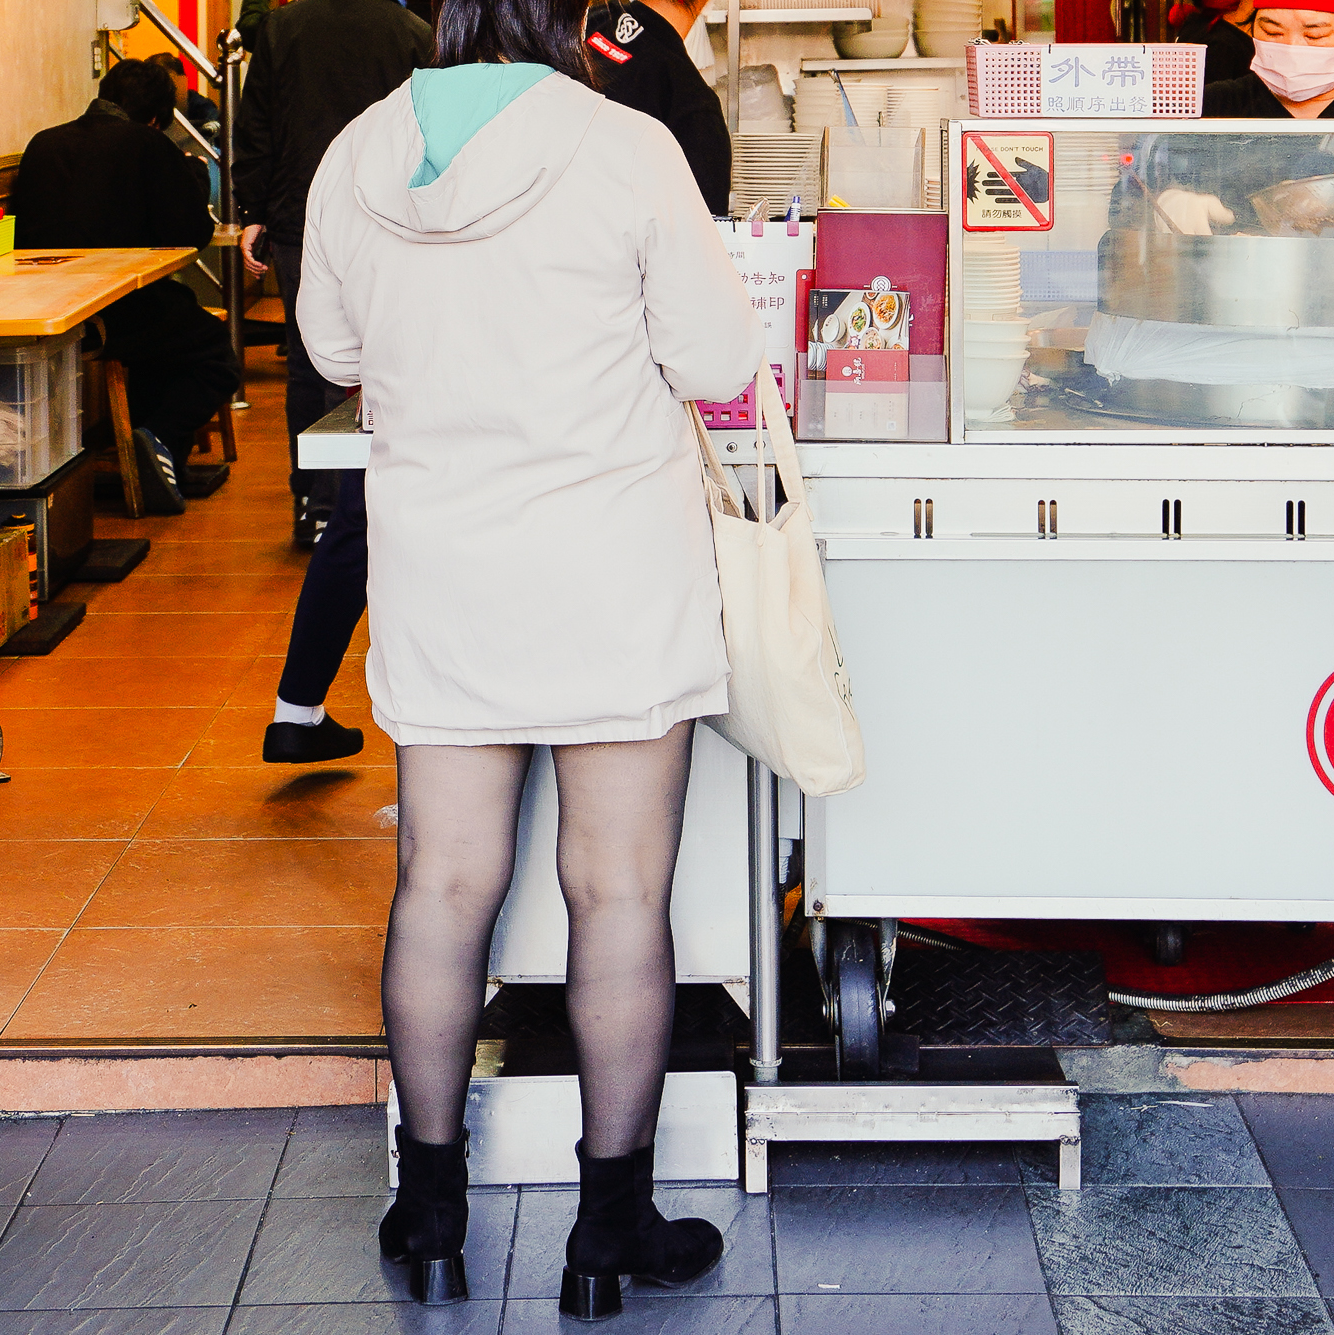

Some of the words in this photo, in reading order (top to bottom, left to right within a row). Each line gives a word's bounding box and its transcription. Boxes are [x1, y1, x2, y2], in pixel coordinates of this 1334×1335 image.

[1048, 56, 1145, 88] 外帶
[981, 209, 1022, 220] 請勿觸摸
